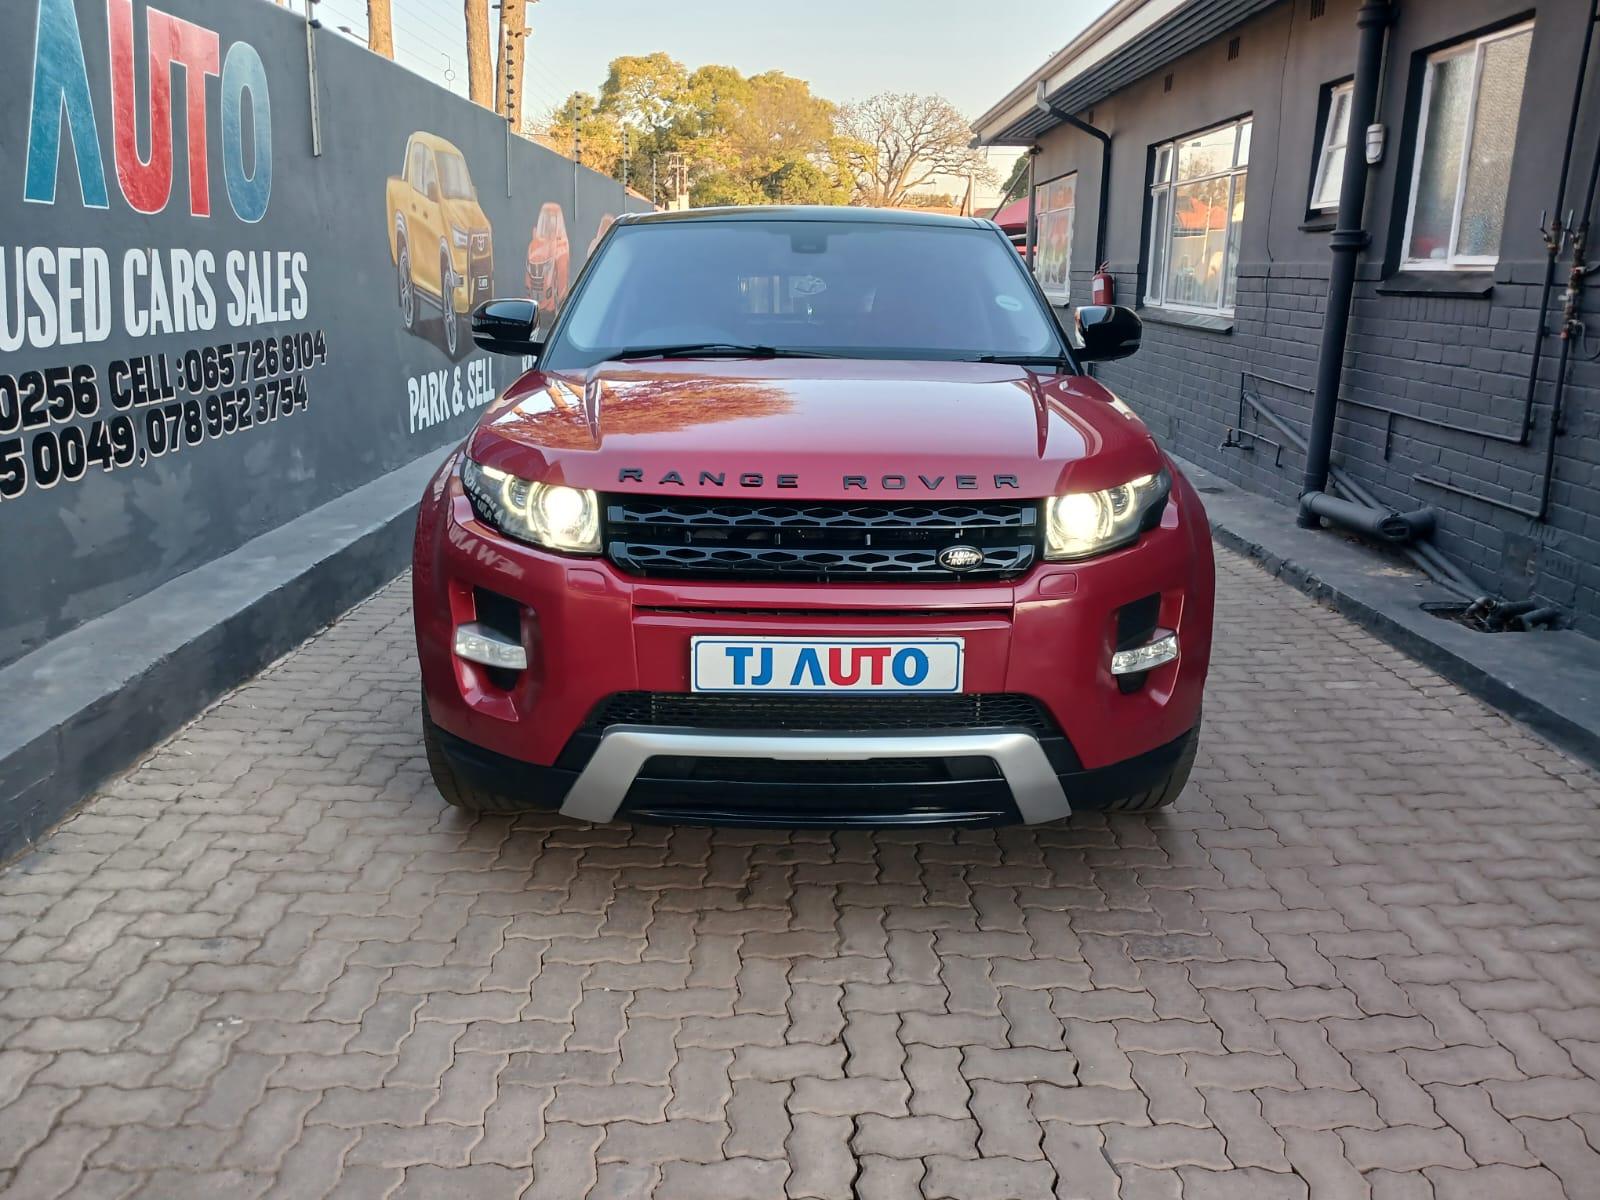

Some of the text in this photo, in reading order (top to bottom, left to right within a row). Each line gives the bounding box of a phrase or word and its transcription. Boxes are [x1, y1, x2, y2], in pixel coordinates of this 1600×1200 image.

[23, 0, 272, 223] AUTO
[0, 246, 308, 351] USED CARS SALES
[408, 356, 495, 434] PARK & SELL
[618, 467, 1020, 490] RANGE ROVER
[948, 551, 970, 559] LAND
[950, 558, 977, 566] ROVER
[725, 647, 929, 687] TJ AUTO
